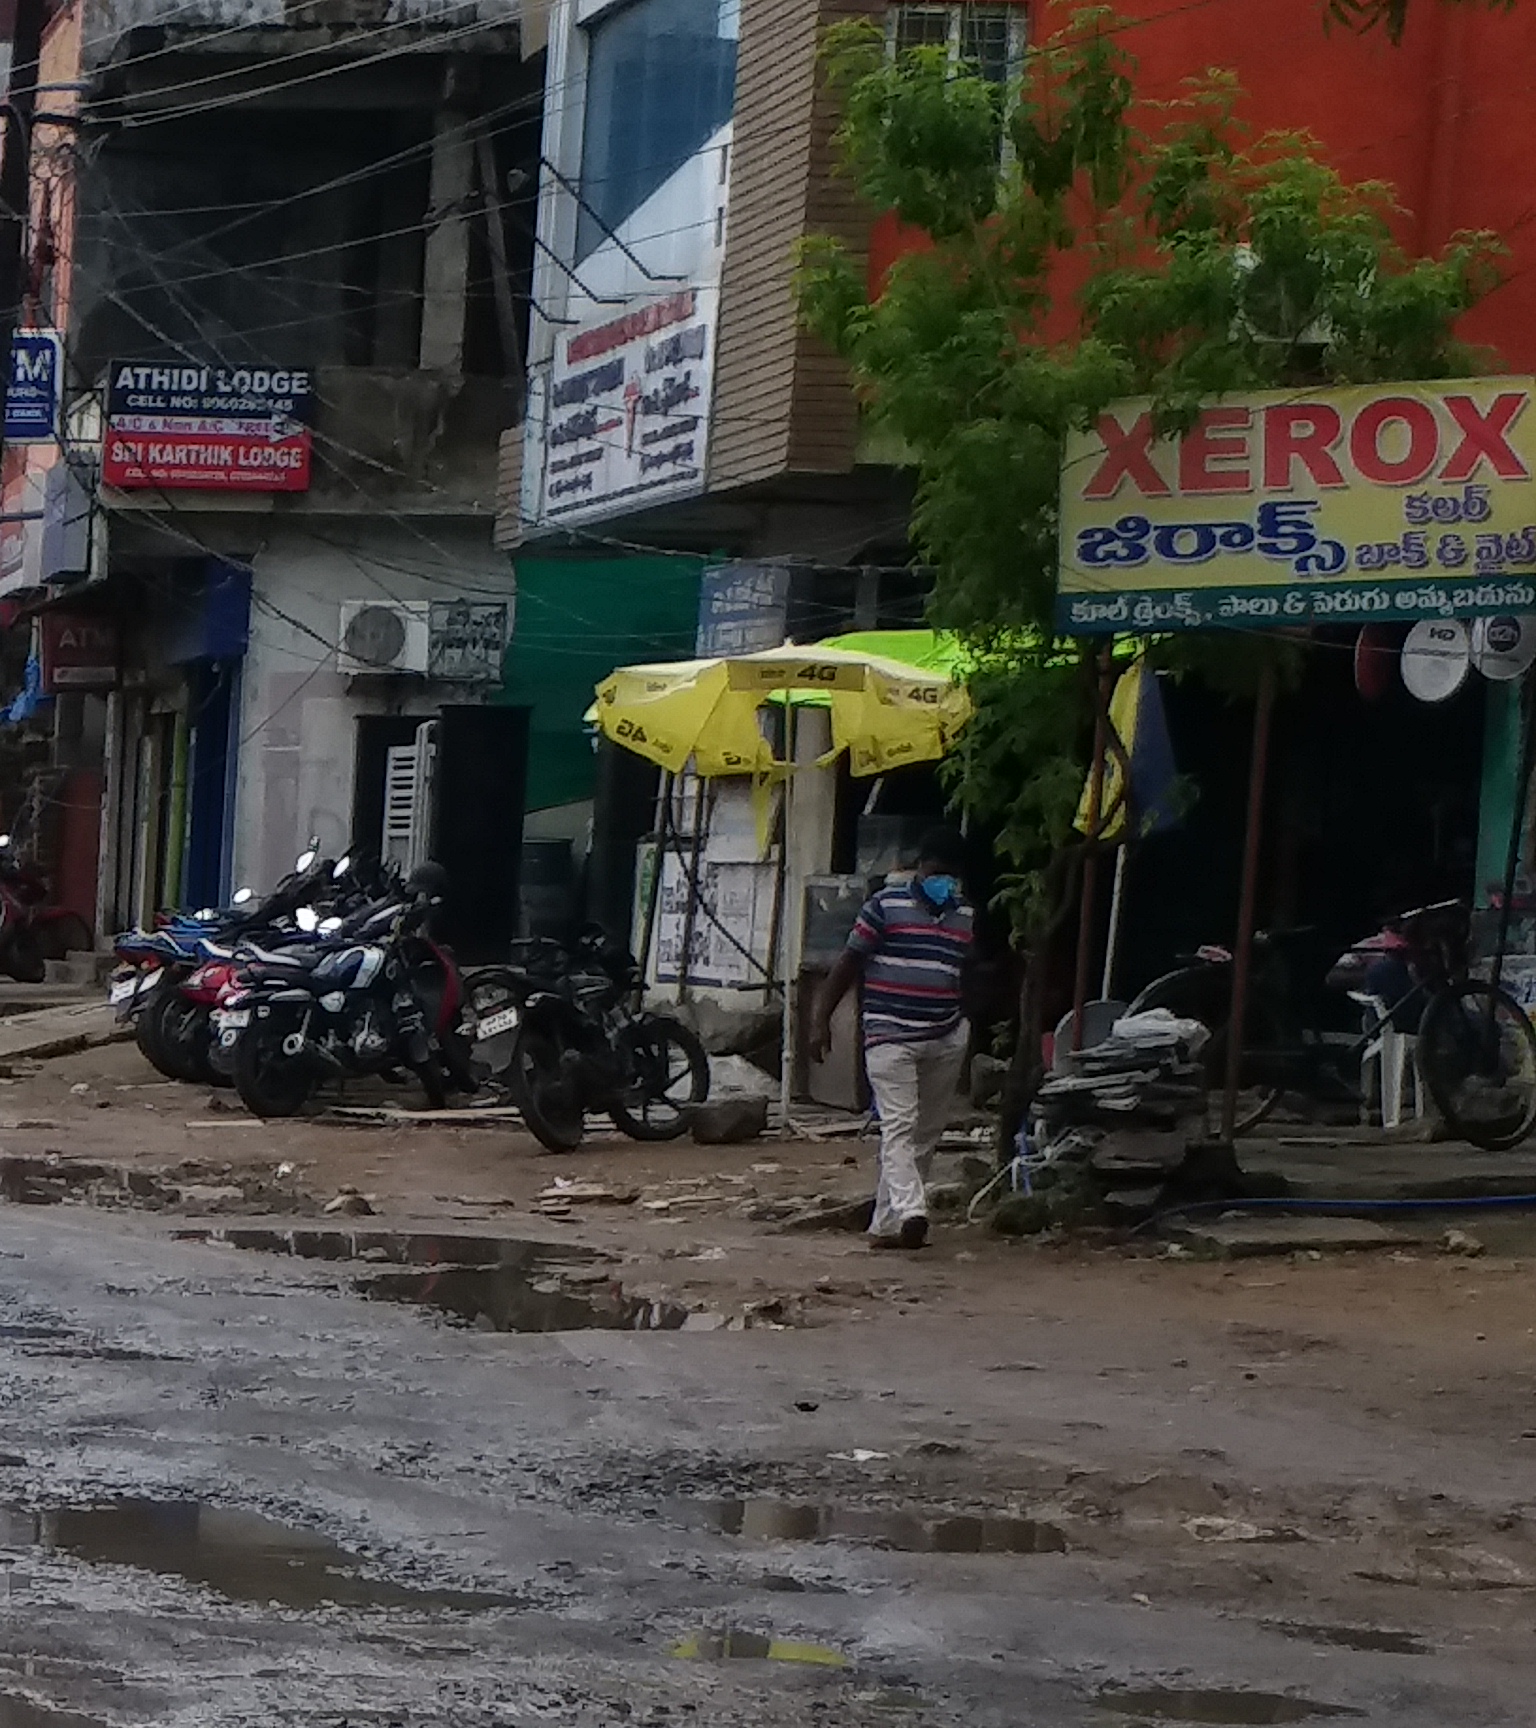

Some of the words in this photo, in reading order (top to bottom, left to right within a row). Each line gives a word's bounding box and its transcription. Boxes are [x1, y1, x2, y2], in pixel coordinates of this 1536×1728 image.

[115, 366, 209, 392] ATHIDI
[216, 369, 310, 395] LODGE
[126, 395, 166, 408] CELL
[111, 441, 143, 463] SRI
[148, 443, 234, 466] KARTHIK
[238, 447, 303, 469] LODGE
[1081, 392, 1529, 499] XEROX
[1405, 484, 1492, 523] కలర్
[1076, 500, 1348, 578] జిరాక్స్
[1437, 534, 1468, 567] &
[1282, 590, 1307, 615] &
[1312, 588, 1391, 615] పెరుగు
[797, 663, 838, 681] 4G
[907, 687, 938, 704] 4G
